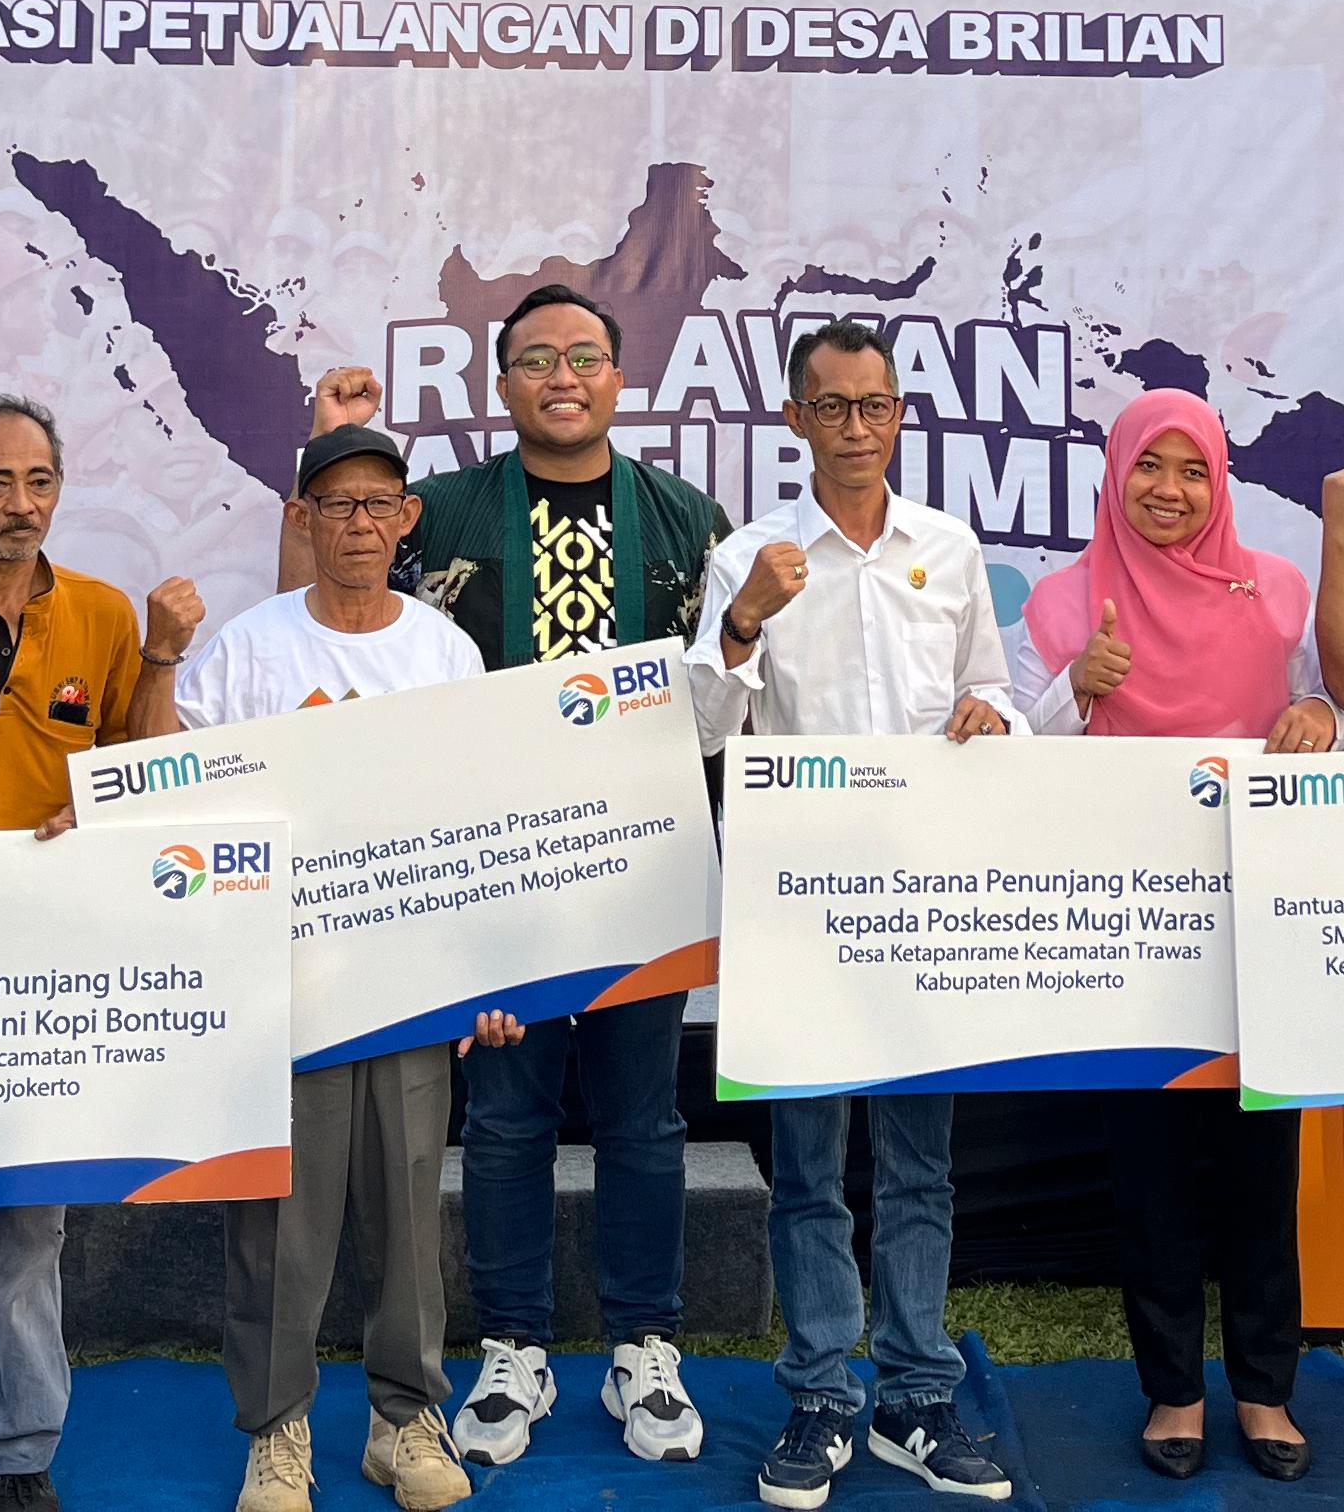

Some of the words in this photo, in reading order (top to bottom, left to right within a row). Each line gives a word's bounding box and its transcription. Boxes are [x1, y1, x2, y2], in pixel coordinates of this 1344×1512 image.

[648, 6, 722, 68] DI
[734, 8, 928, 73] DESA
[931, 11, 1223, 77] BRILIAN
[613, 659, 670, 695] BRI
[618, 690, 672, 716] peduli
[91, 752, 201, 803] BUMN
[203, 753, 244, 770] UNTUK
[205, 760, 267, 783] INDONESIA
[745, 756, 846, 789] BUMN
[850, 766, 887, 777] UNTUK
[849, 778, 907, 789] INDONESIA
[291, 836, 425, 876] Peningkatan
[429, 820, 501, 848] Sarana
[506, 799, 608, 832] Prasarana
[213, 841, 271, 874] BRI
[290, 879, 369, 907] Mutiara
[372, 858, 475, 890] Welirang,
[478, 846, 531, 869] Desa
[535, 816, 675, 858] Ketapanrame
[213, 875, 270, 895] peduli
[316, 904, 394, 933] Trawas
[398, 880, 515, 917] Kabupaten
[520, 856, 628, 892] Mojokerto
[777, 870, 884, 895] Bantuan
[892, 868, 977, 893] Sarana
[986, 868, 1123, 899] Penunjang
[1131, 867, 1233, 894] Kesehat
[825, 907, 919, 940] kepada
[927, 905, 1058, 932] Poskesdes
[1066, 906, 1130, 937] Mugi
[1137, 906, 1215, 931] Waras
[838, 944, 884, 963] Desa
[890, 942, 1018, 966] Ketapanrame
[1024, 941, 1129, 960] Kecamatan
[1133, 940, 1202, 960] Trawas
[119, 963, 202, 991] Usaha
[915, 971, 1020, 995] Kabupaten
[1025, 969, 1124, 994] Mojokerto
[35, 1007, 96, 1040] Kopi
[105, 1007, 226, 1037] Bontugu
[91, 1044, 165, 1064] Trawas
